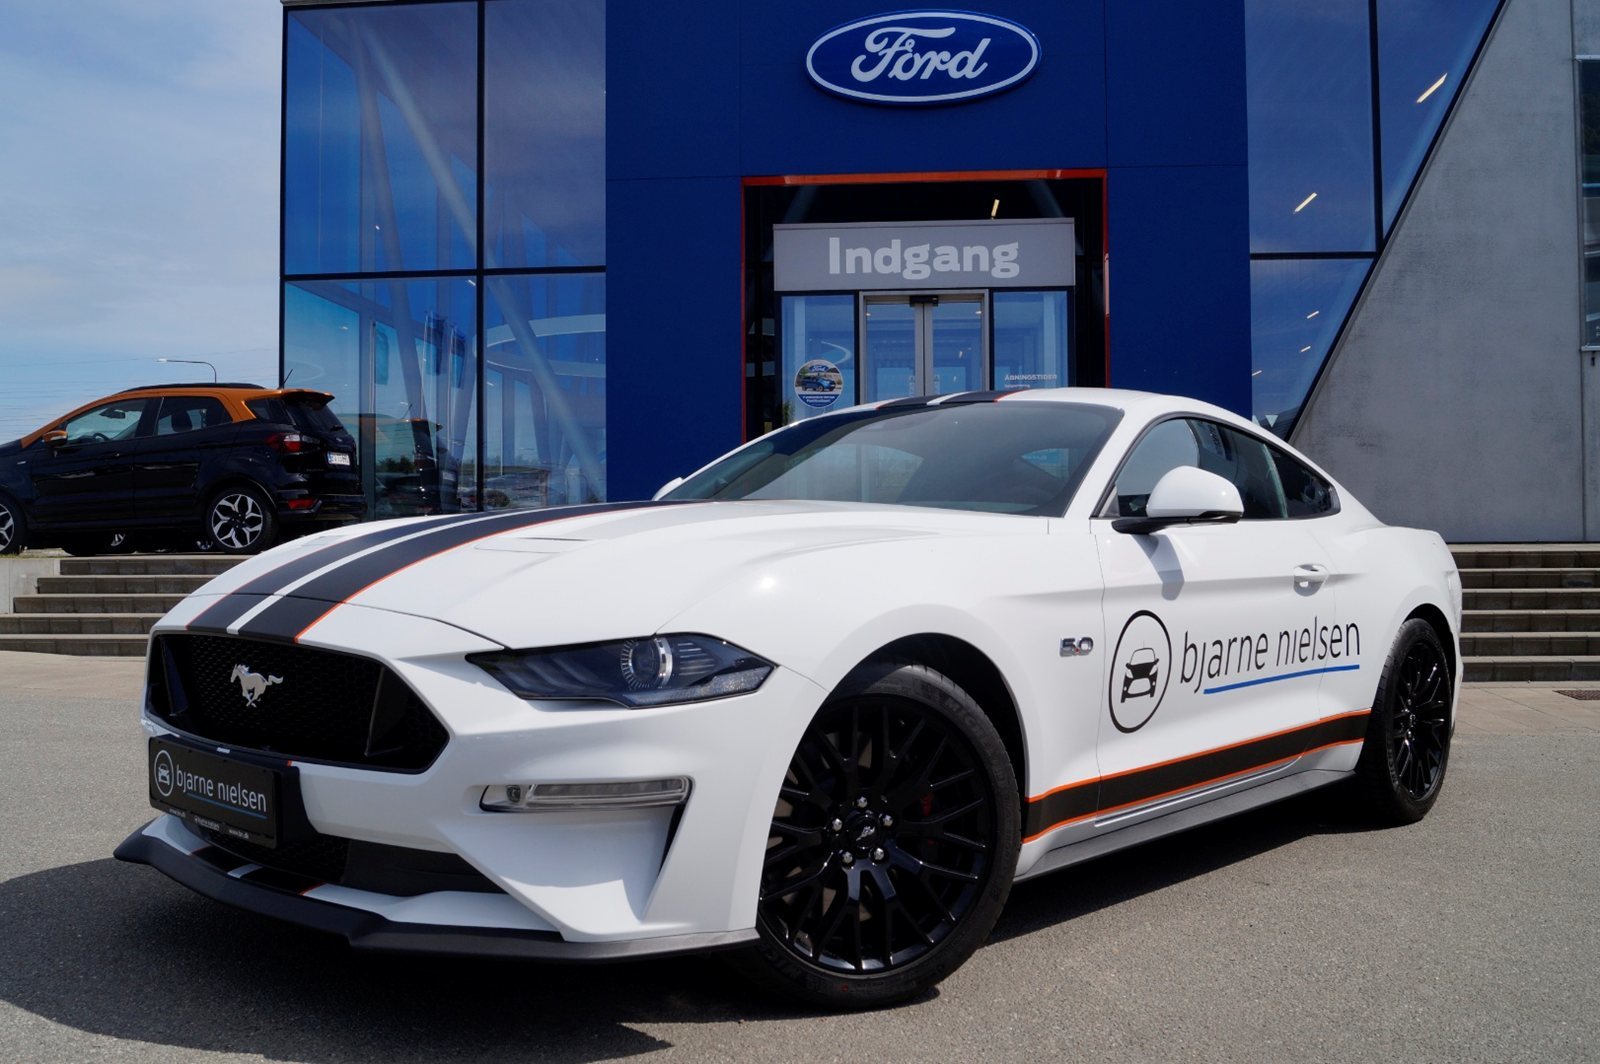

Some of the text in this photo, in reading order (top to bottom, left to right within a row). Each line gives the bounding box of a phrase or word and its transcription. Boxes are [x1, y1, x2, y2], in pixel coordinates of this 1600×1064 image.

[851, 26, 991, 82] Ford
[829, 237, 1020, 280] Indgang
[1180, 616, 1360, 694] bjarne nielsen
[176, 764, 267, 812] bjarne nielsen
